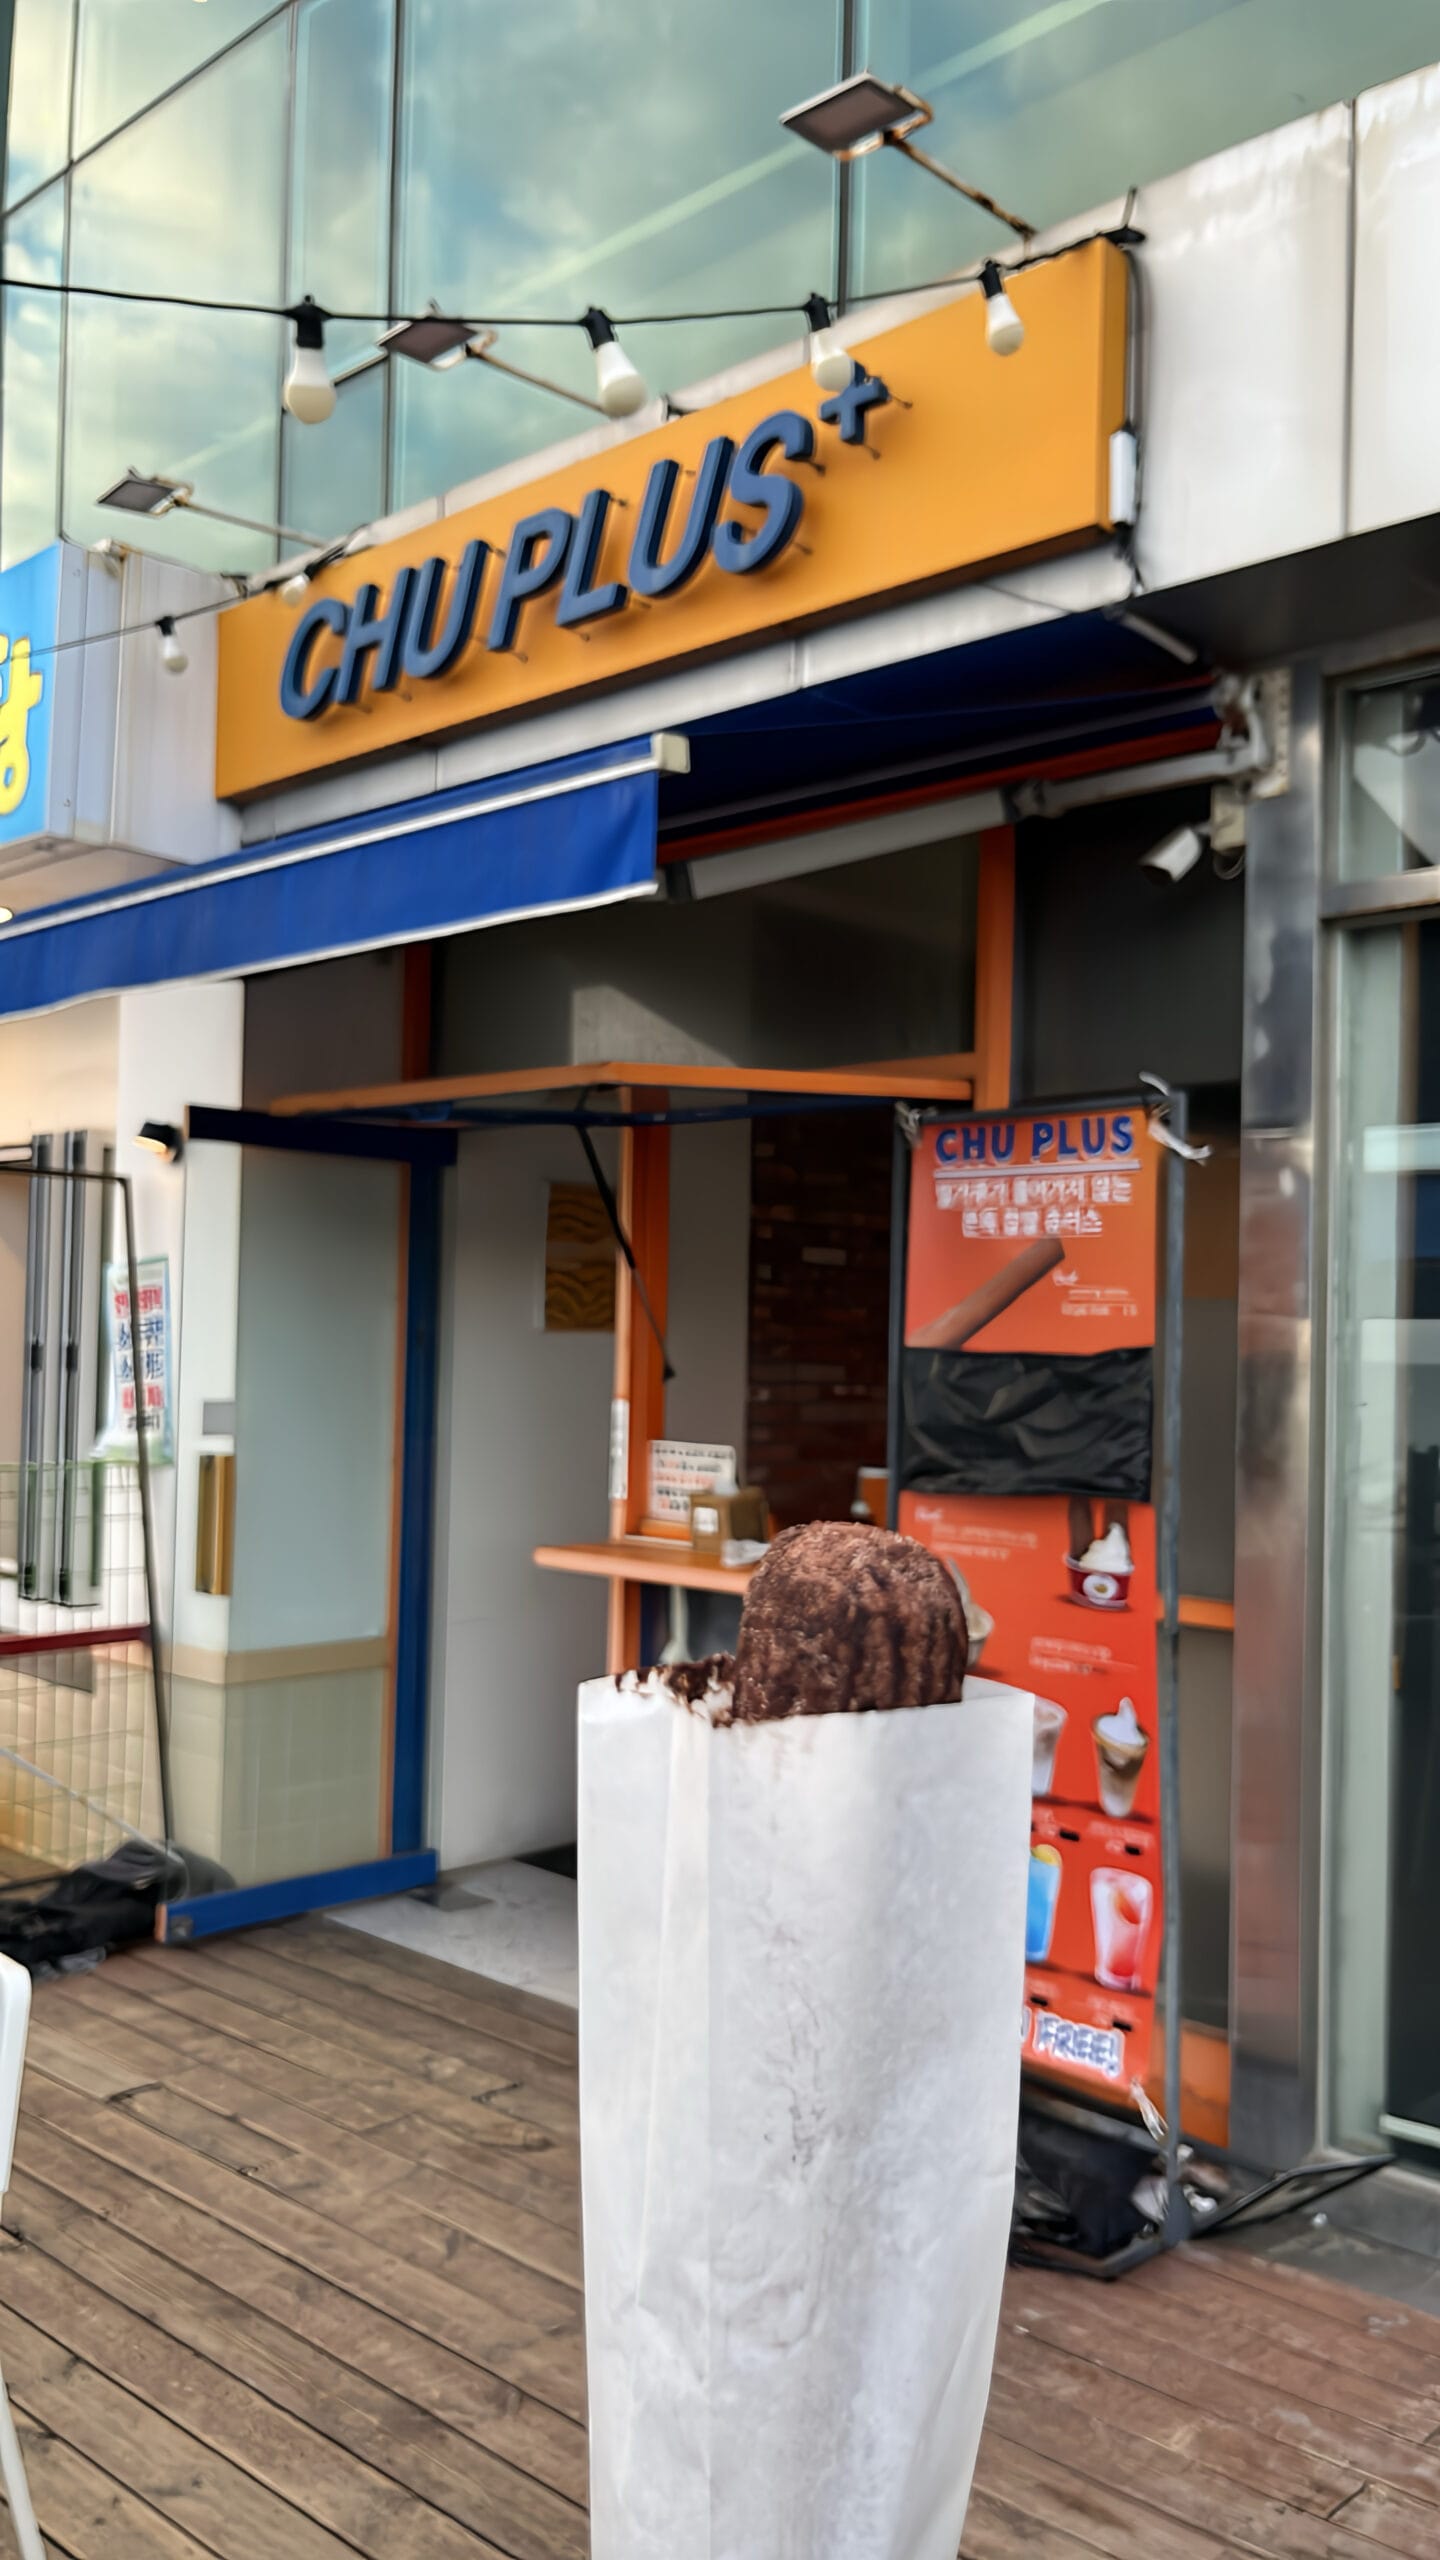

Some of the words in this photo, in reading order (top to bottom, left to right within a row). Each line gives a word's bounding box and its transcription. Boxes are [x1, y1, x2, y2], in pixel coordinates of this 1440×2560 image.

[279, 539, 490, 721] CHU
[935, 1123, 1016, 1164] CHU
[1031, 1115, 1135, 1160] PLUS
